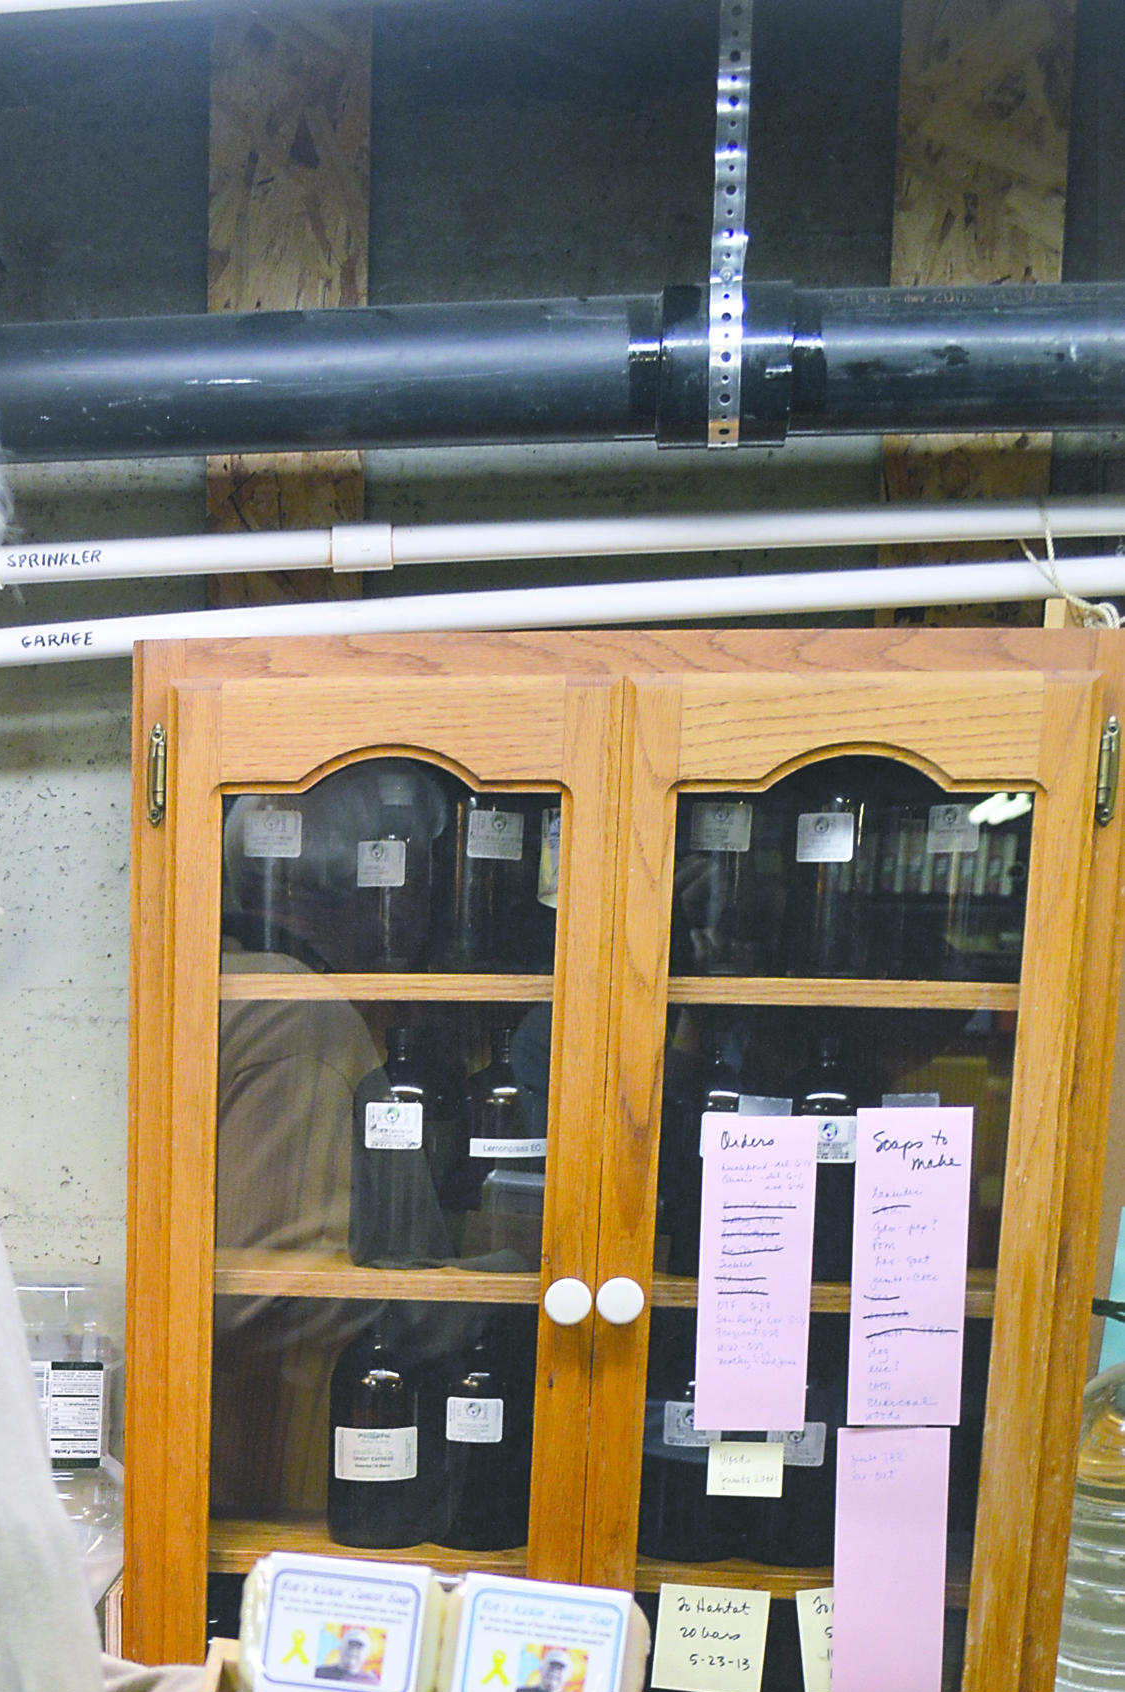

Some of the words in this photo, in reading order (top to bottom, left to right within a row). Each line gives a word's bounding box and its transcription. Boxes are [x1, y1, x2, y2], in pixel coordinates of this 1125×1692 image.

[7, 549, 102, 568] SPRINKLER
[21, 631, 93, 649] GARAGE
[483, 1143, 529, 1154] Lemongrass
[721, 1131, 774, 1150] Orders
[873, 1131, 923, 1160] Soaps
[931, 1130, 948, 1145] to
[911, 1154, 962, 1171] make
[696, 1598, 751, 1615] Habitat
[680, 1626, 697, 1638] 20
[701, 1626, 741, 1640] bars
[689, 1653, 750, 1671] 5-23-13
